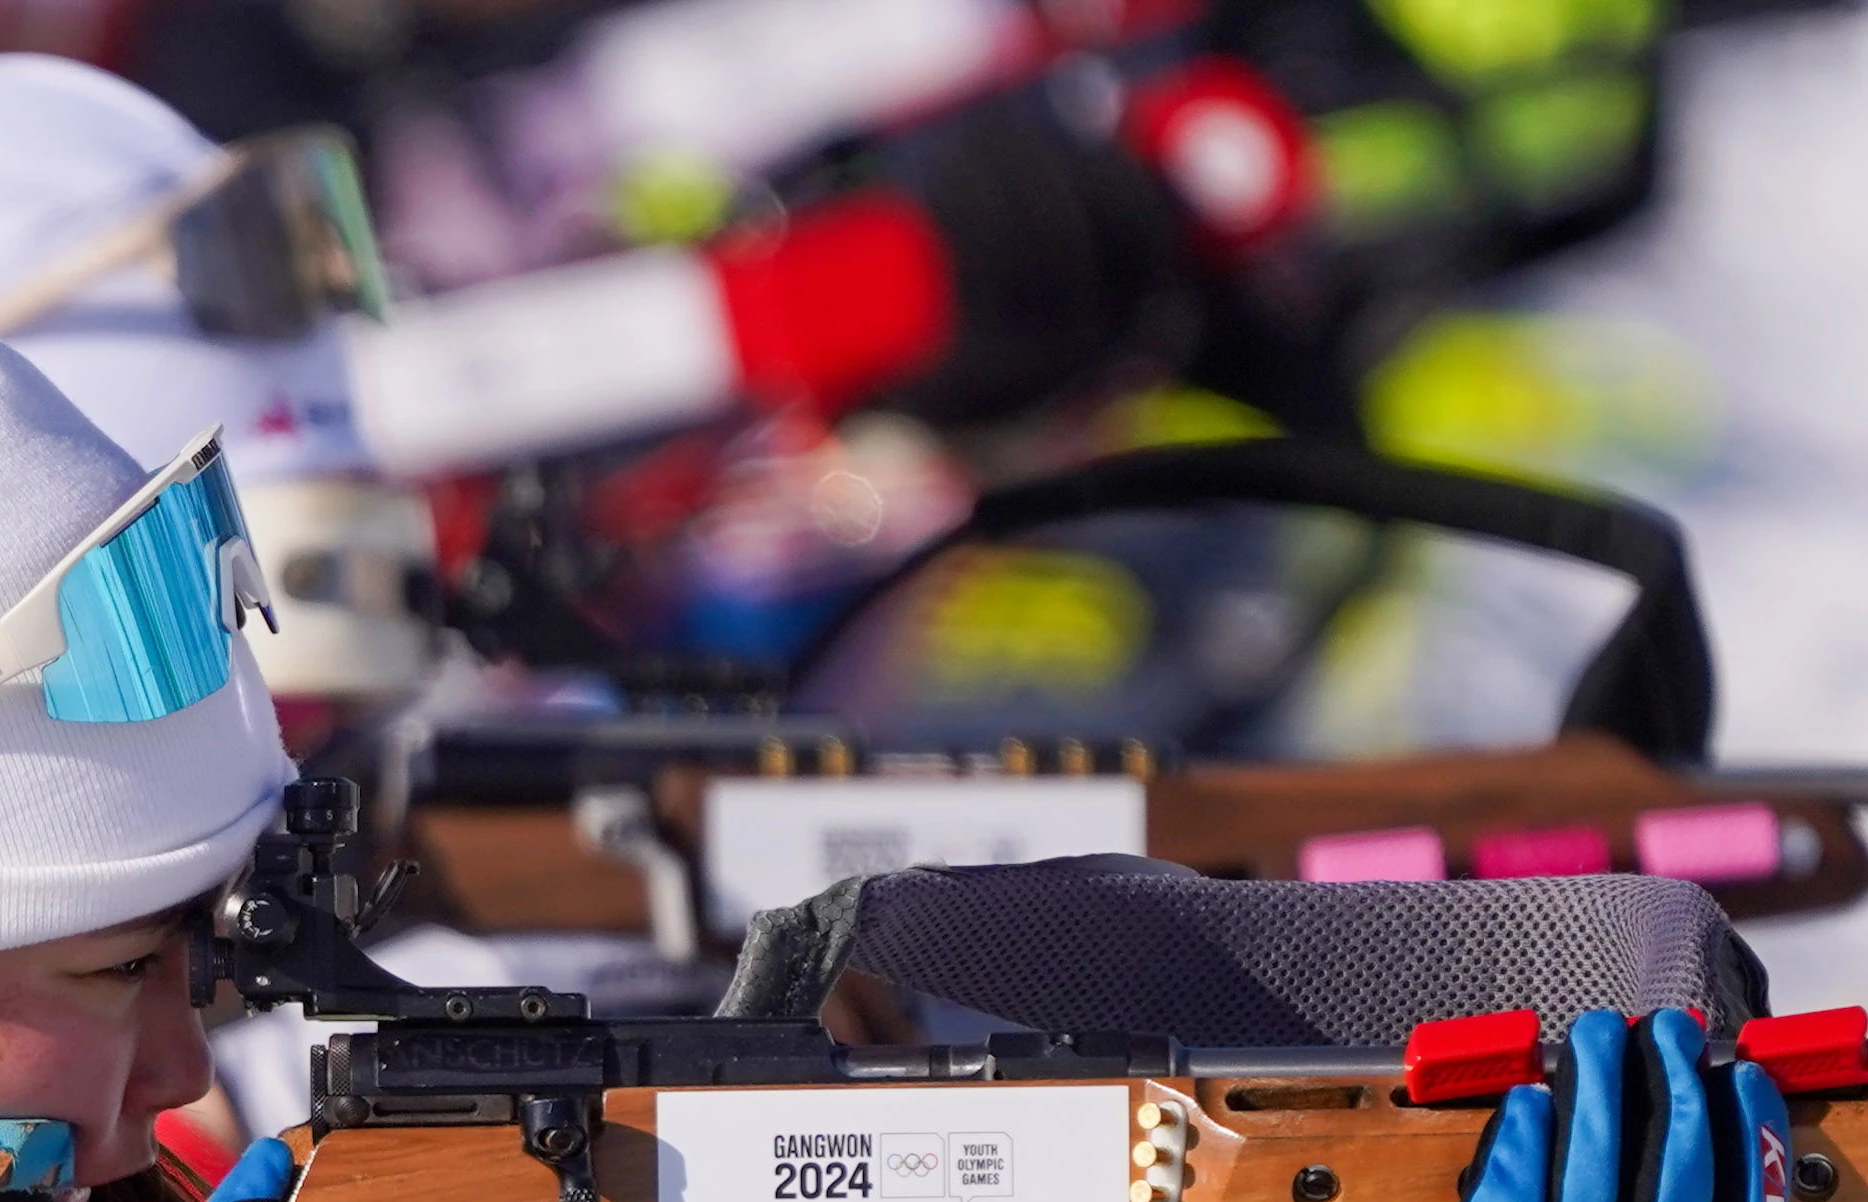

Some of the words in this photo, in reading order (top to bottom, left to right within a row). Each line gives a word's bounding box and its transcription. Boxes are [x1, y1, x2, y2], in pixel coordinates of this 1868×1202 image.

[774, 1133, 873, 1159] GANGWON
[963, 1143, 998, 1157] YOUTH
[957, 1157, 1005, 1172] OLYMPIC
[774, 1161, 873, 1199] 2024
[962, 1172, 1001, 1186] GAMES
